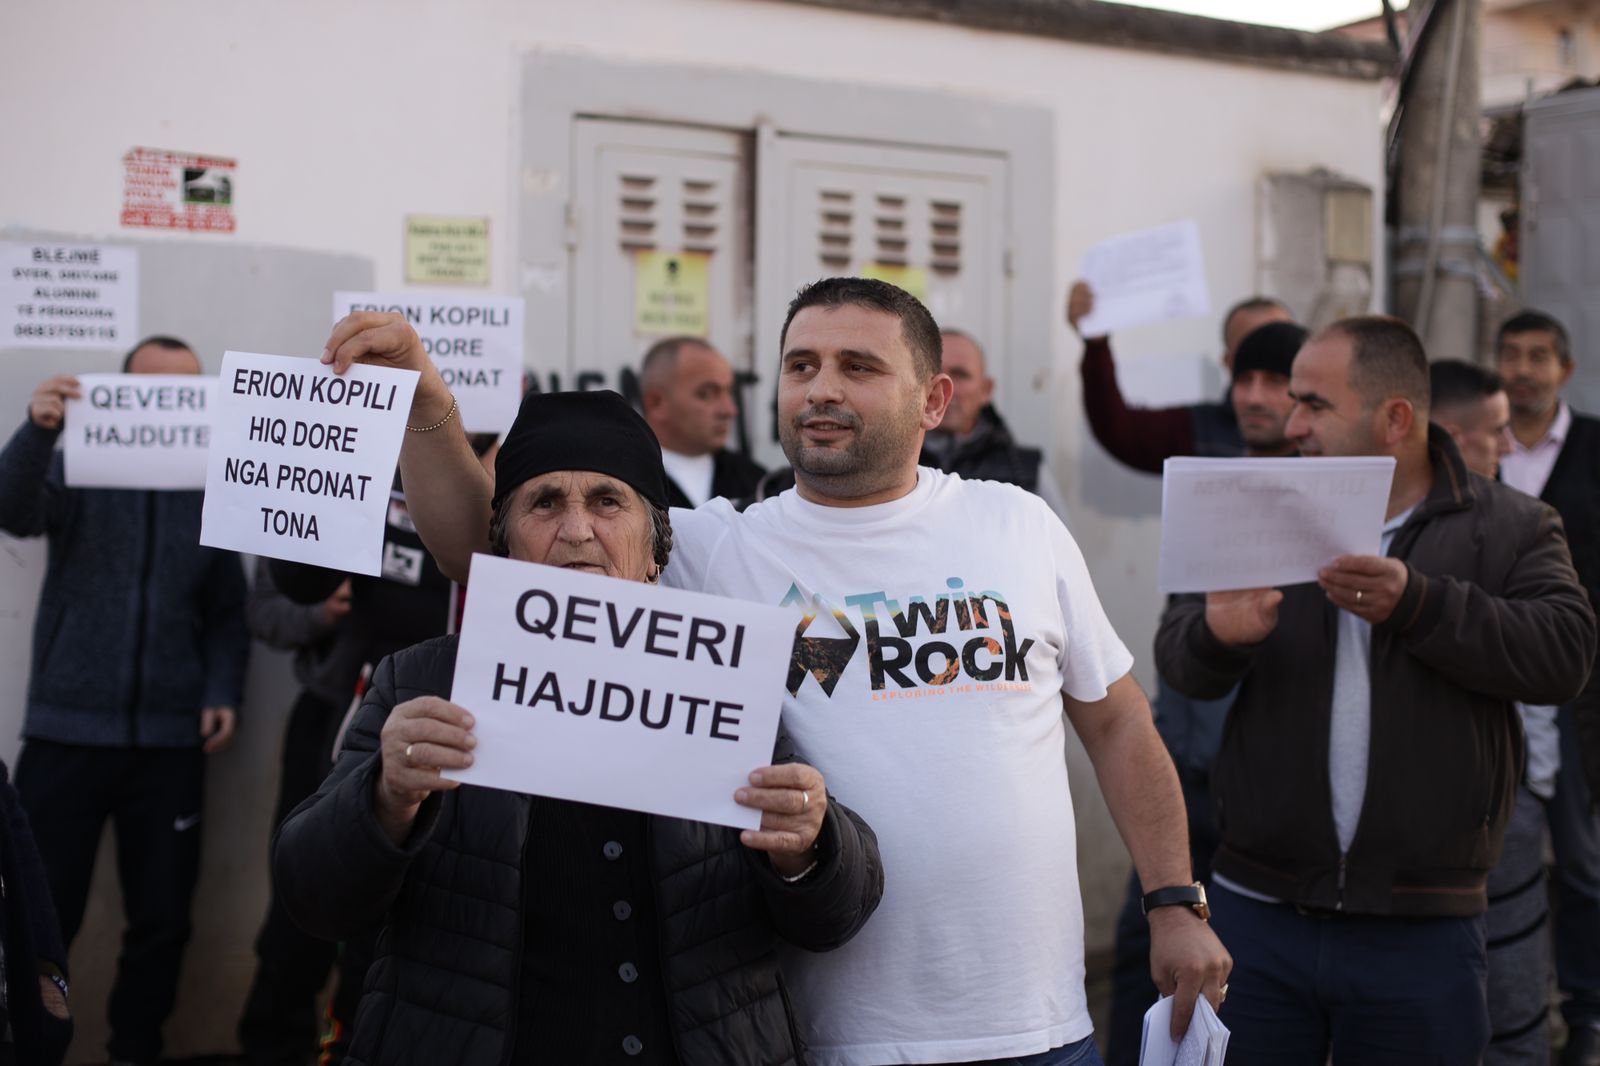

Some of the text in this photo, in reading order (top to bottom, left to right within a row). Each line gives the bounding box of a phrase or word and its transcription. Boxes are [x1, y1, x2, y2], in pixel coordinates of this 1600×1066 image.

[429, 306, 509, 327] KOPILI
[232, 368, 397, 411] ERION KOPILI
[441, 368, 502, 387] ONAT
[89, 385, 206, 413] QEVERI
[84, 425, 210, 449] HAJDUTE
[249, 416, 359, 454] HIQ DORE
[225, 457, 372, 502] NGA PRONAT
[260, 507, 320, 542] TONA
[515, 588, 746, 669] QEVERI
[492, 662, 744, 742] HAJDUTE
